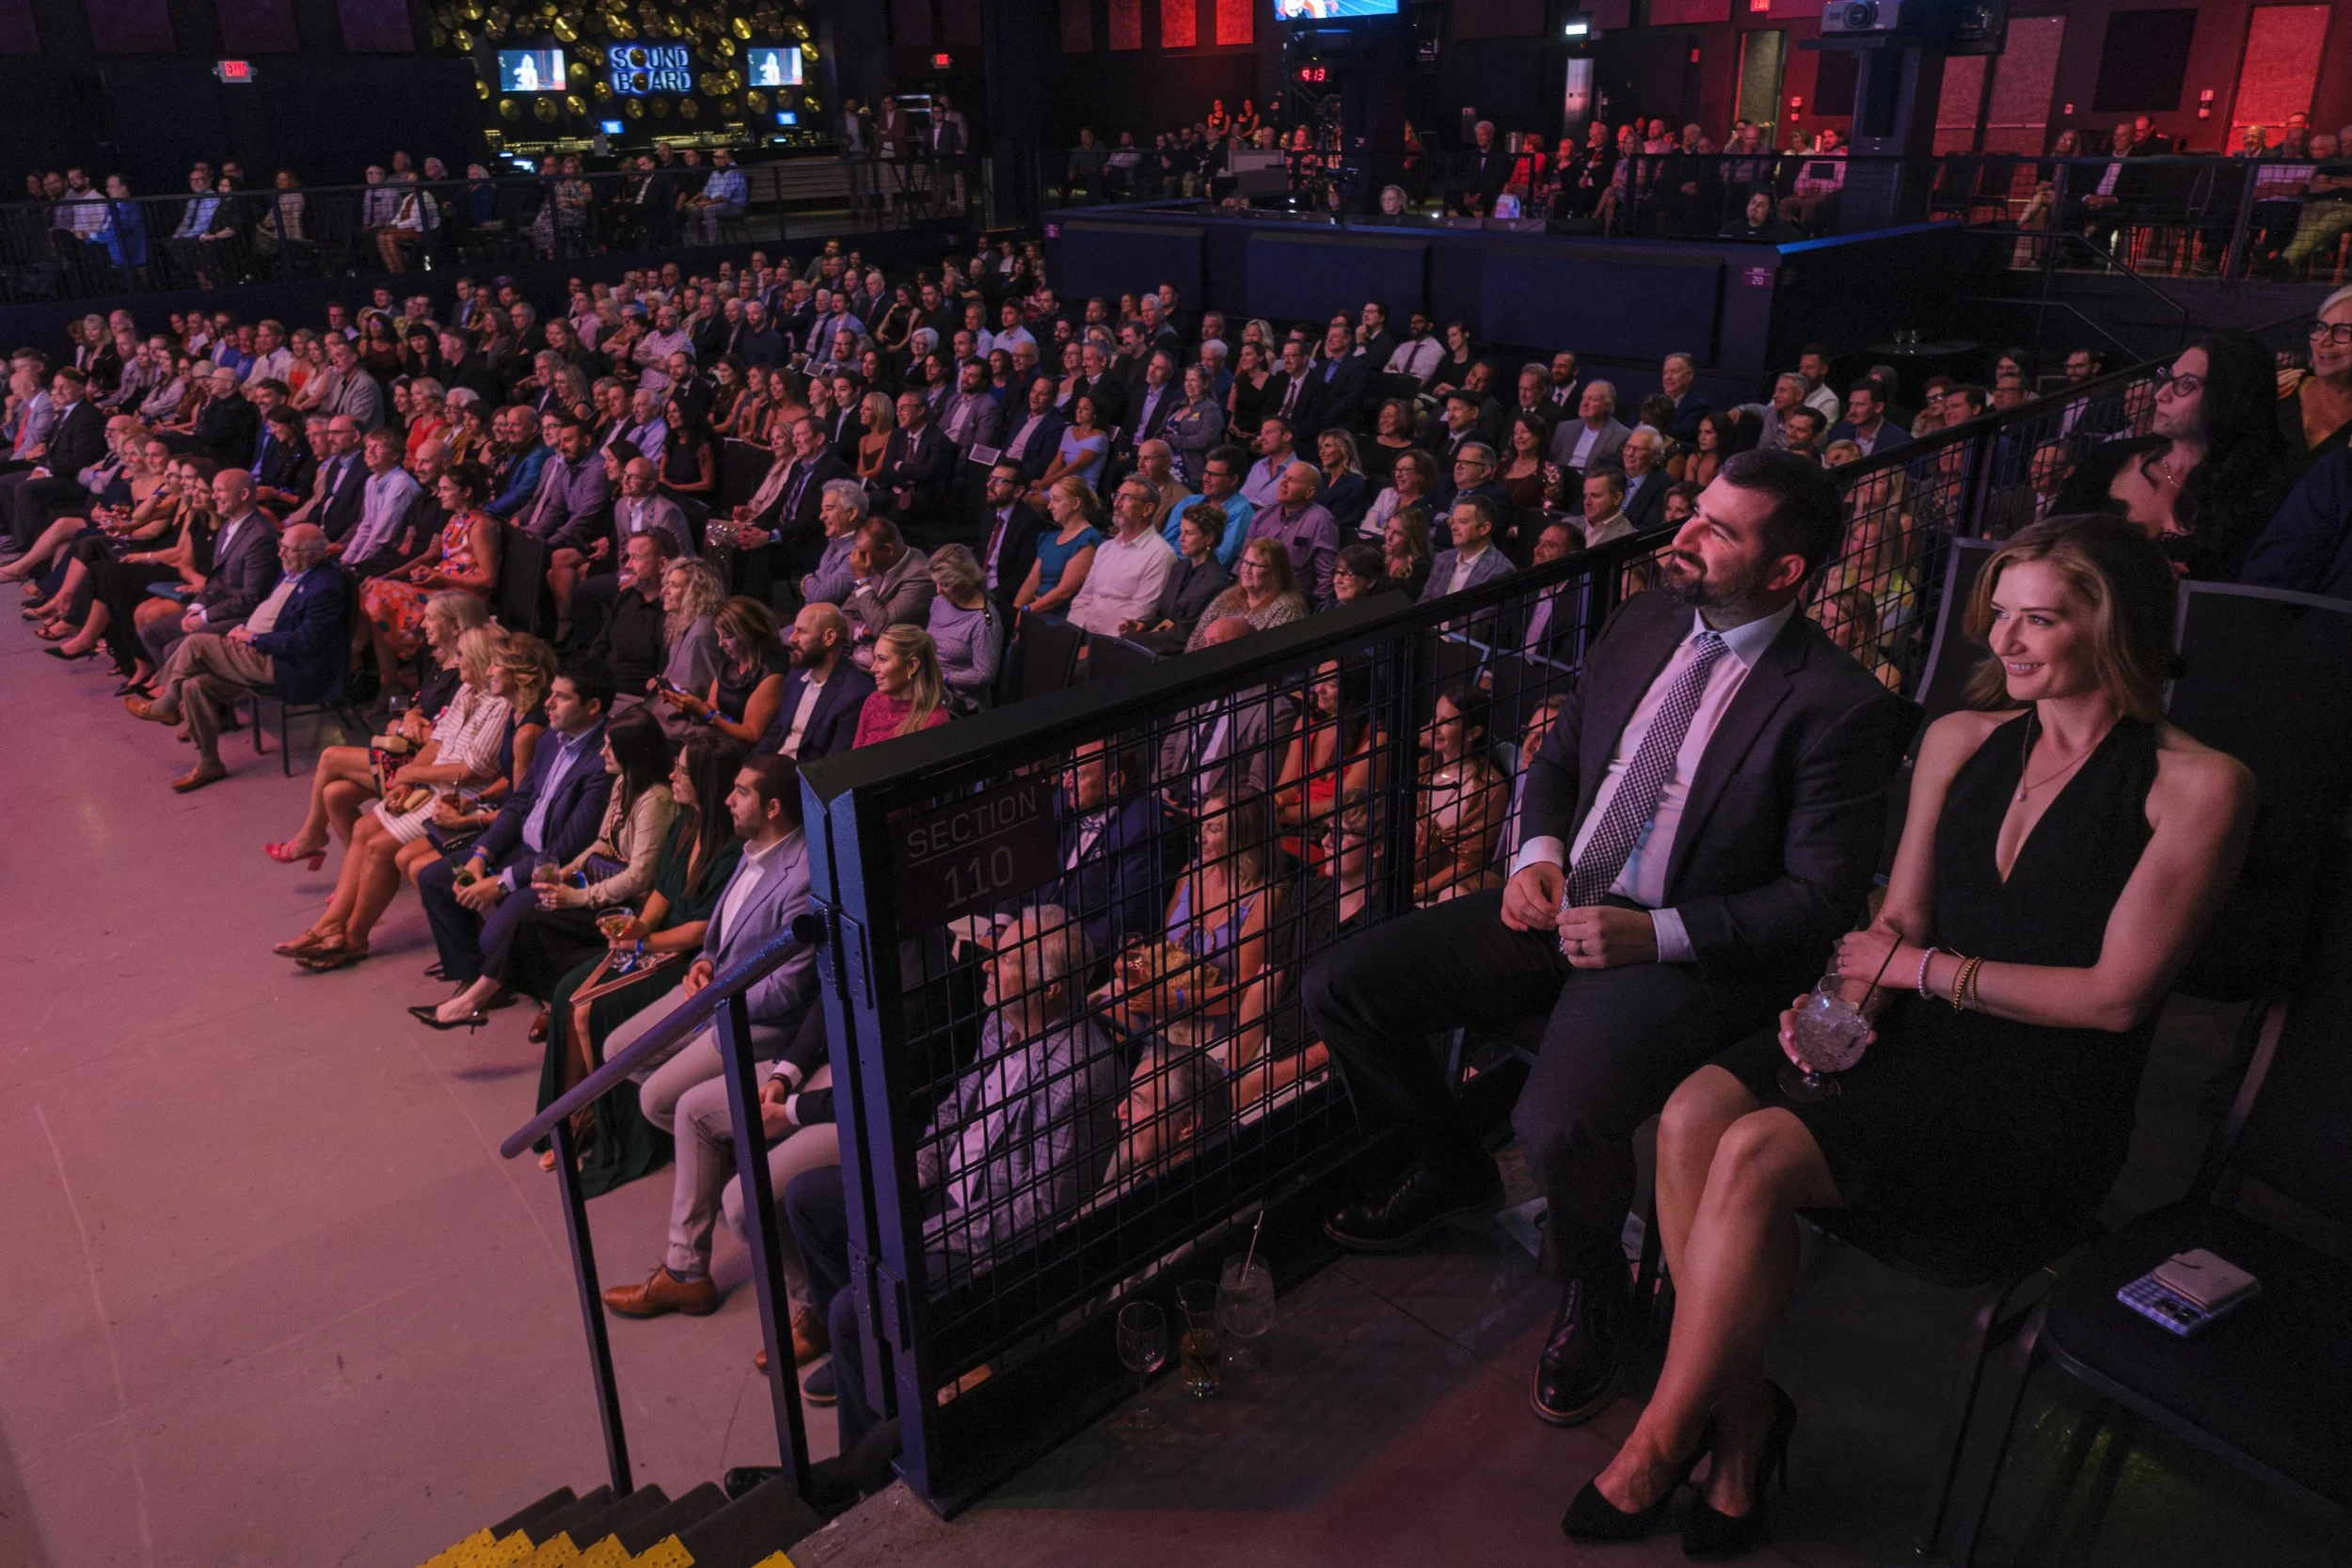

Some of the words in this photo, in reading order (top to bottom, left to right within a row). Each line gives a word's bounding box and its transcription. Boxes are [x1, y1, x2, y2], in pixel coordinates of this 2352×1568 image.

[612, 48, 689, 69] SOUND
[616, 71, 691, 91] BOARD
[907, 786, 1036, 859] SECTION
[945, 846, 1013, 909] 110
